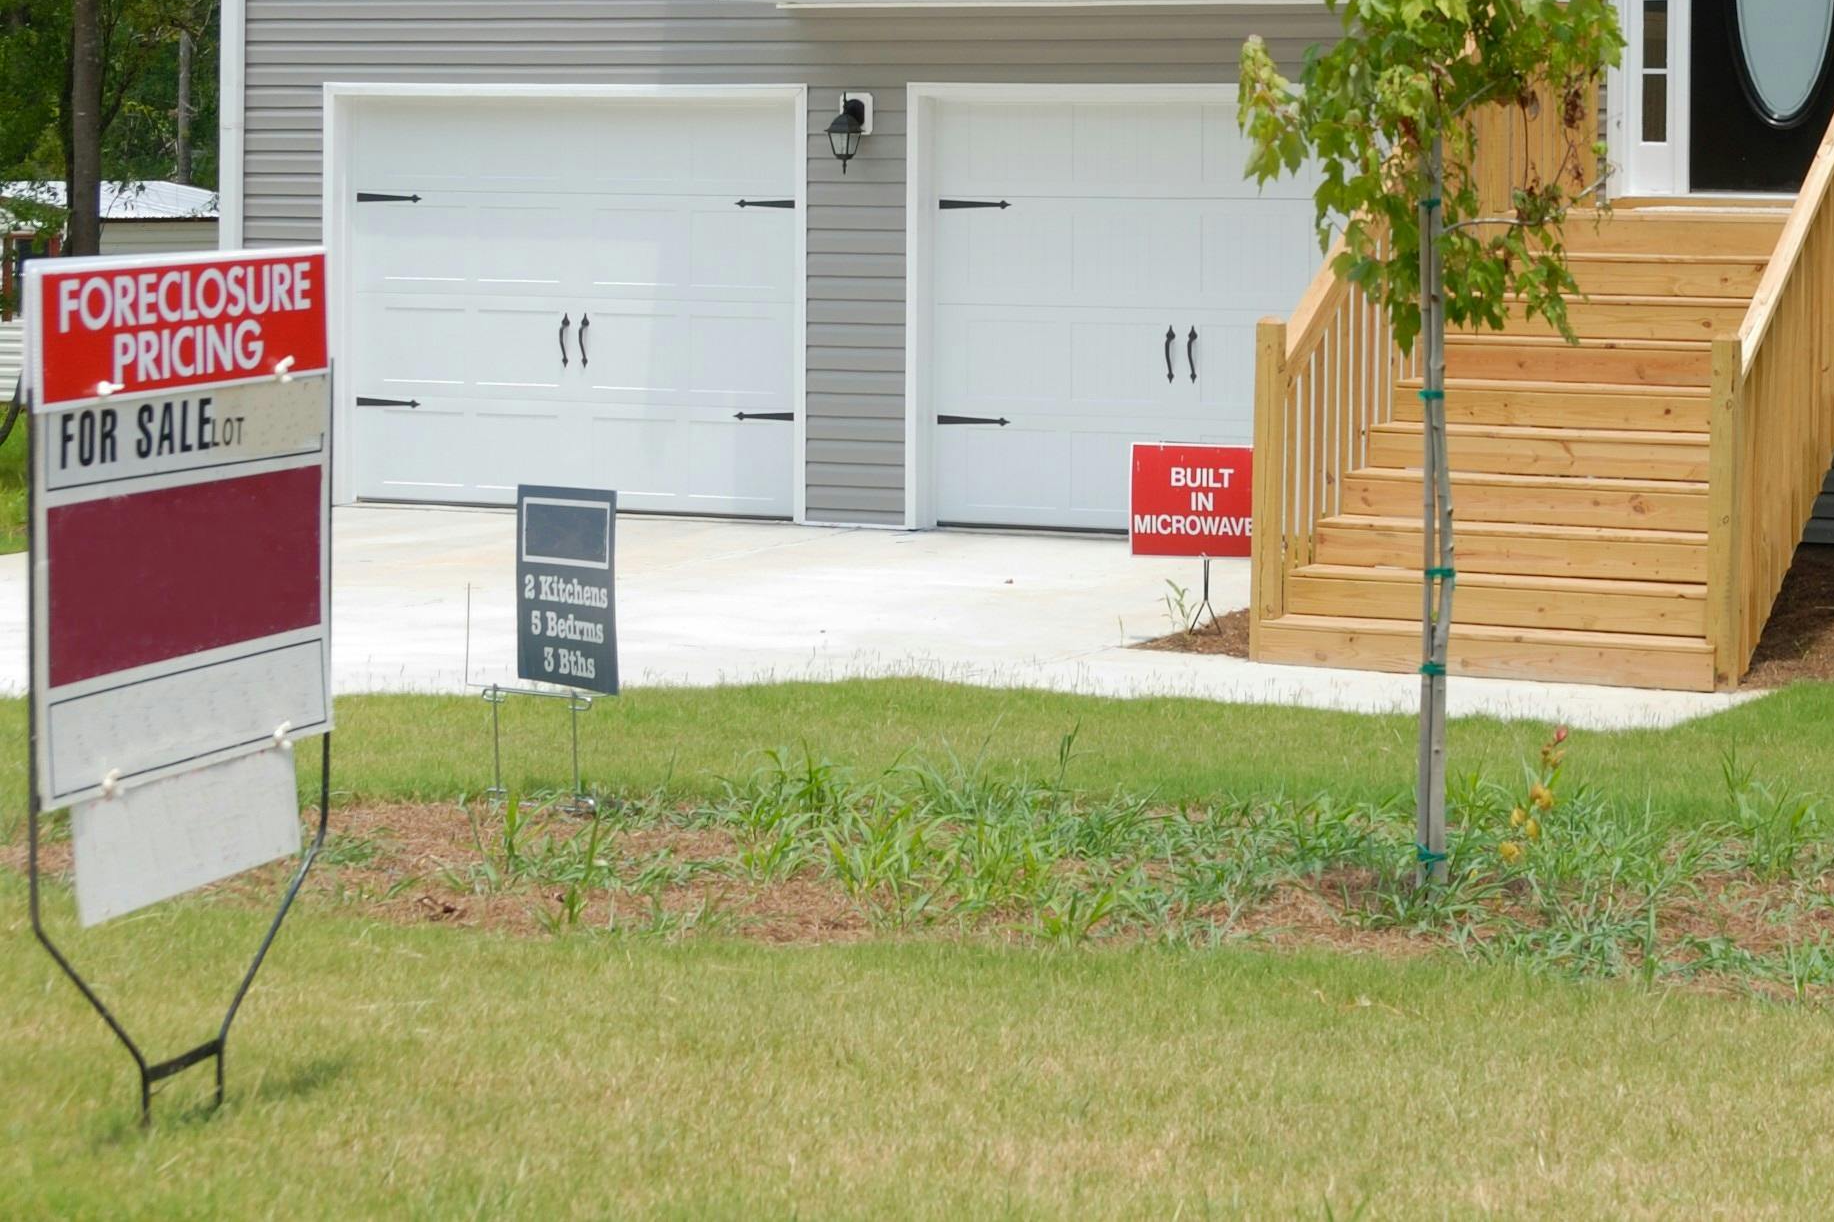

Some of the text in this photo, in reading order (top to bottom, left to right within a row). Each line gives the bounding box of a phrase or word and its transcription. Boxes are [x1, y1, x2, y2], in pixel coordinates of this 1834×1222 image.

[58, 262, 311, 333] FORECLOSURE
[113, 319, 264, 384] PRICING
[60, 398, 245, 469] FOR SALE LOT
[1170, 467, 1234, 488] BUILT
[1191, 492, 1214, 511] IN
[524, 574, 608, 609] 2 Kitchens
[531, 611, 604, 644] 5 Bedrms
[544, 647, 595, 678] 3 Bths
